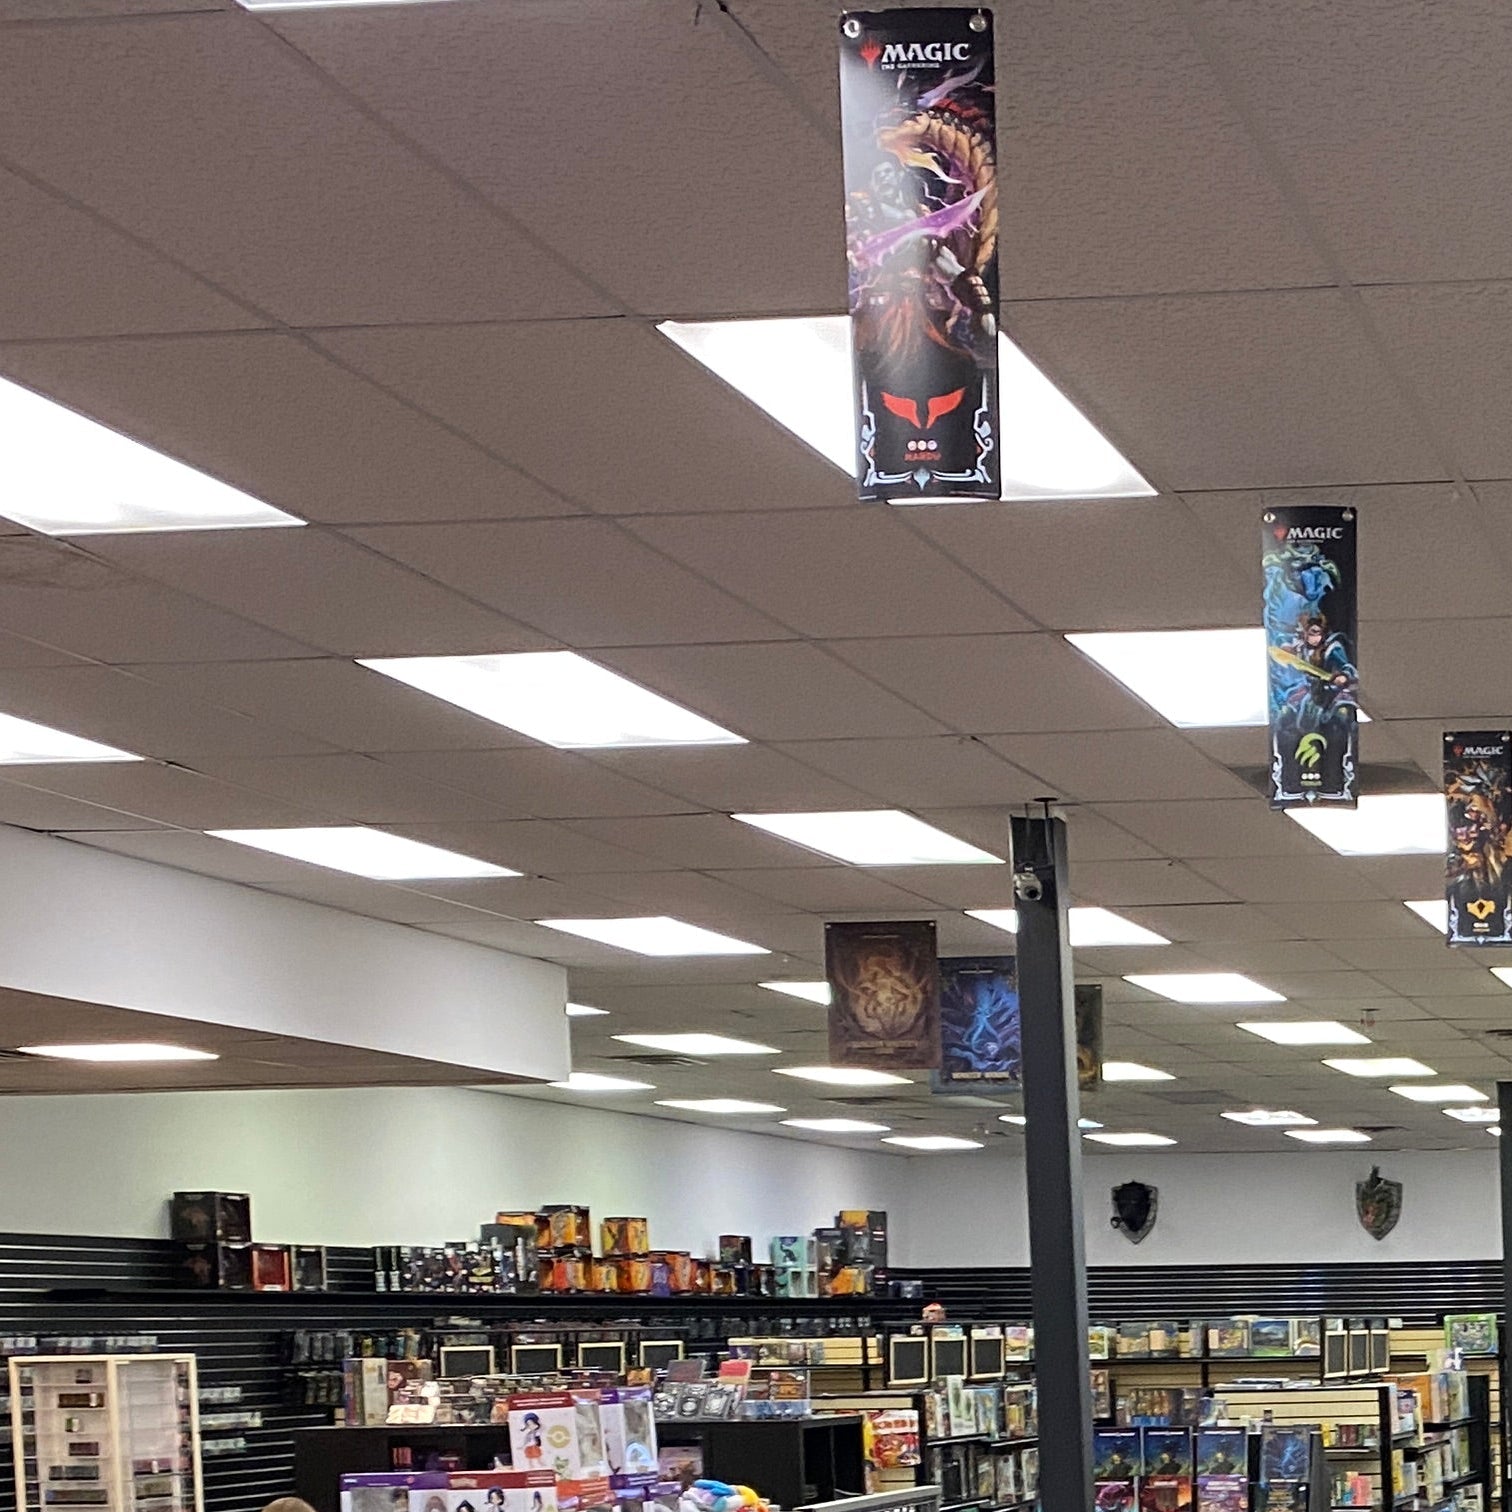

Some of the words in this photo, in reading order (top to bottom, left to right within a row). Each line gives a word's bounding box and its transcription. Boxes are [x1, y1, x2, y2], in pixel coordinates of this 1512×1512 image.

[881, 43, 970, 61] MAGIC
[1286, 526, 1344, 539] MAGIC
[1463, 746, 1504, 755] MAGIC
